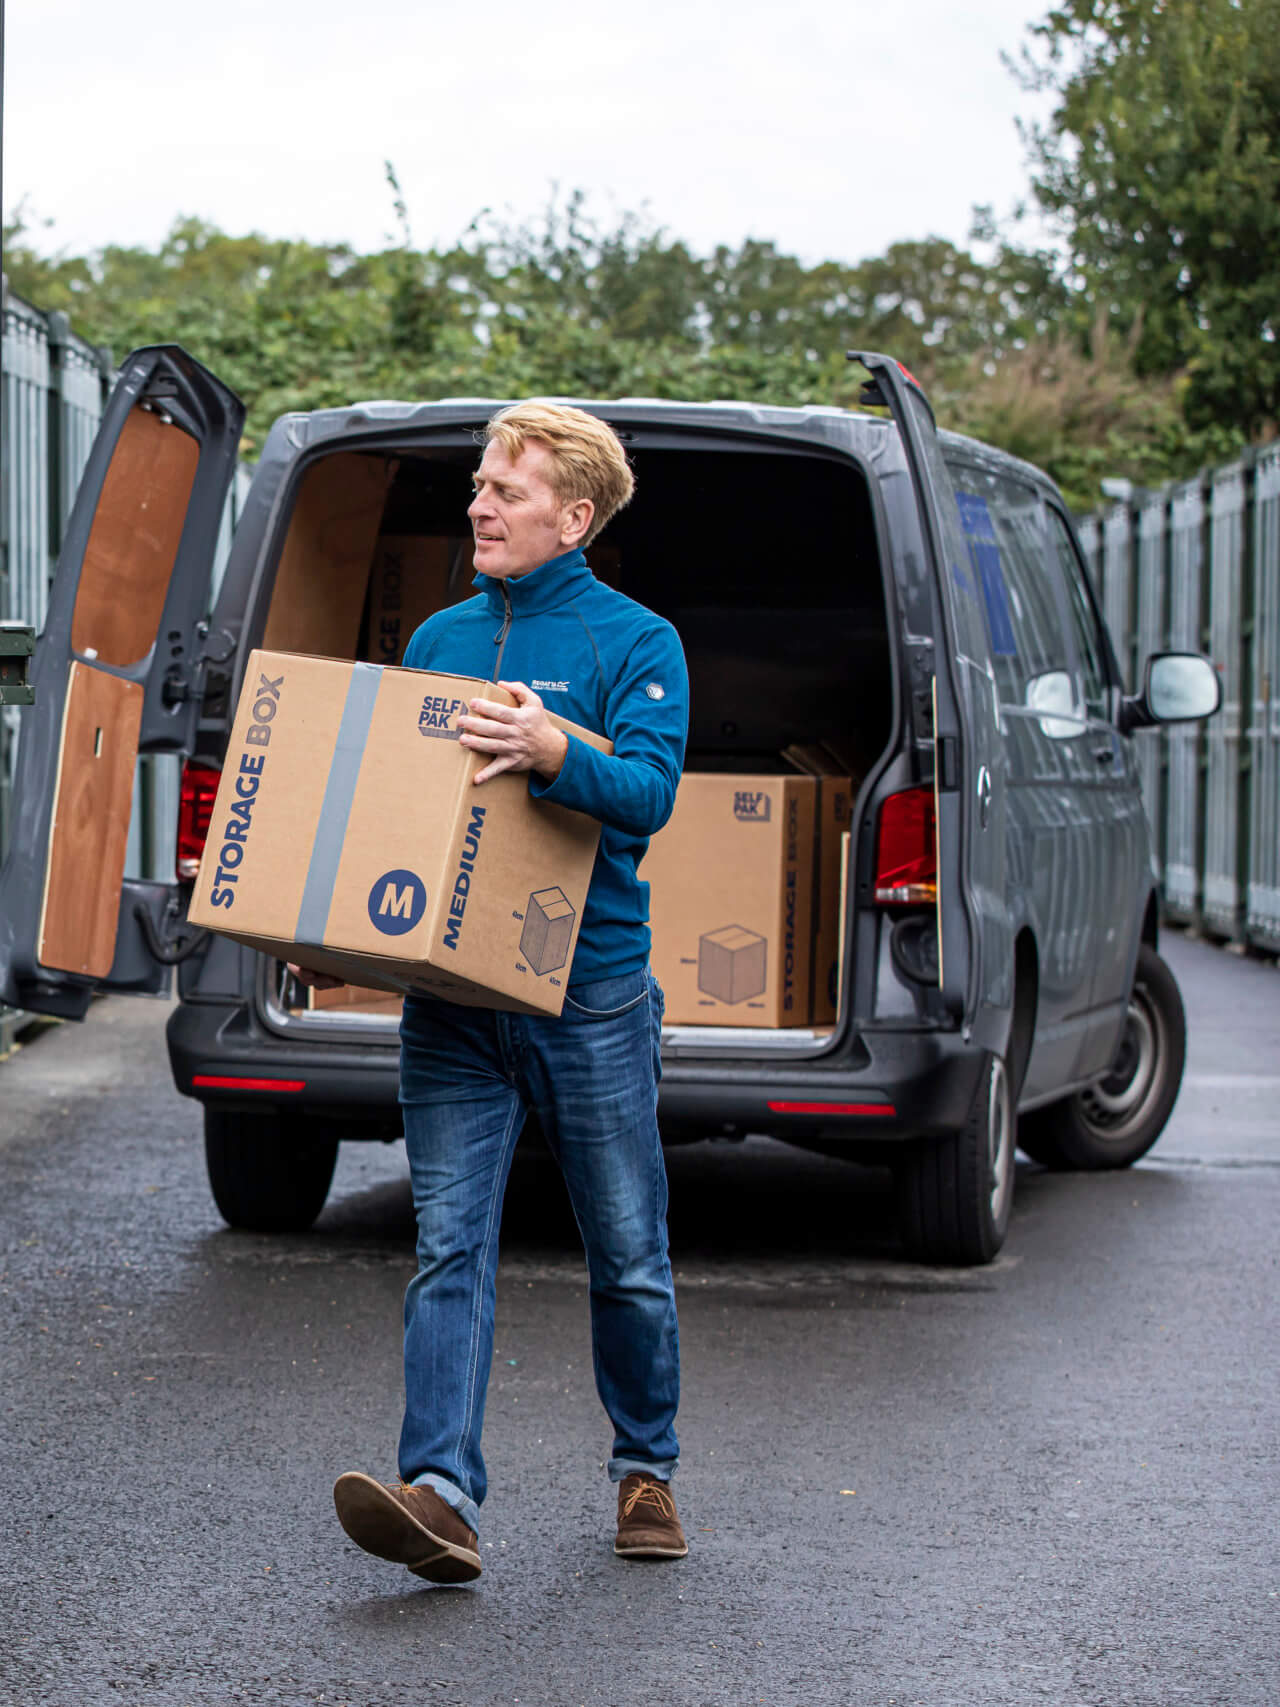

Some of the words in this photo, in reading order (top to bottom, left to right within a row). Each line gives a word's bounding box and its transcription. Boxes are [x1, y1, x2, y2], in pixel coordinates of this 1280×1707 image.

[418, 710, 452, 729] PAK
[422, 695, 462, 714] SELF
[210, 753, 266, 909] STORAGE
[246, 673, 285, 747] BOX
[377, 882, 416, 920] M
[443, 806, 487, 951] MEDIUM
[783, 871, 797, 1011] STORAGE
